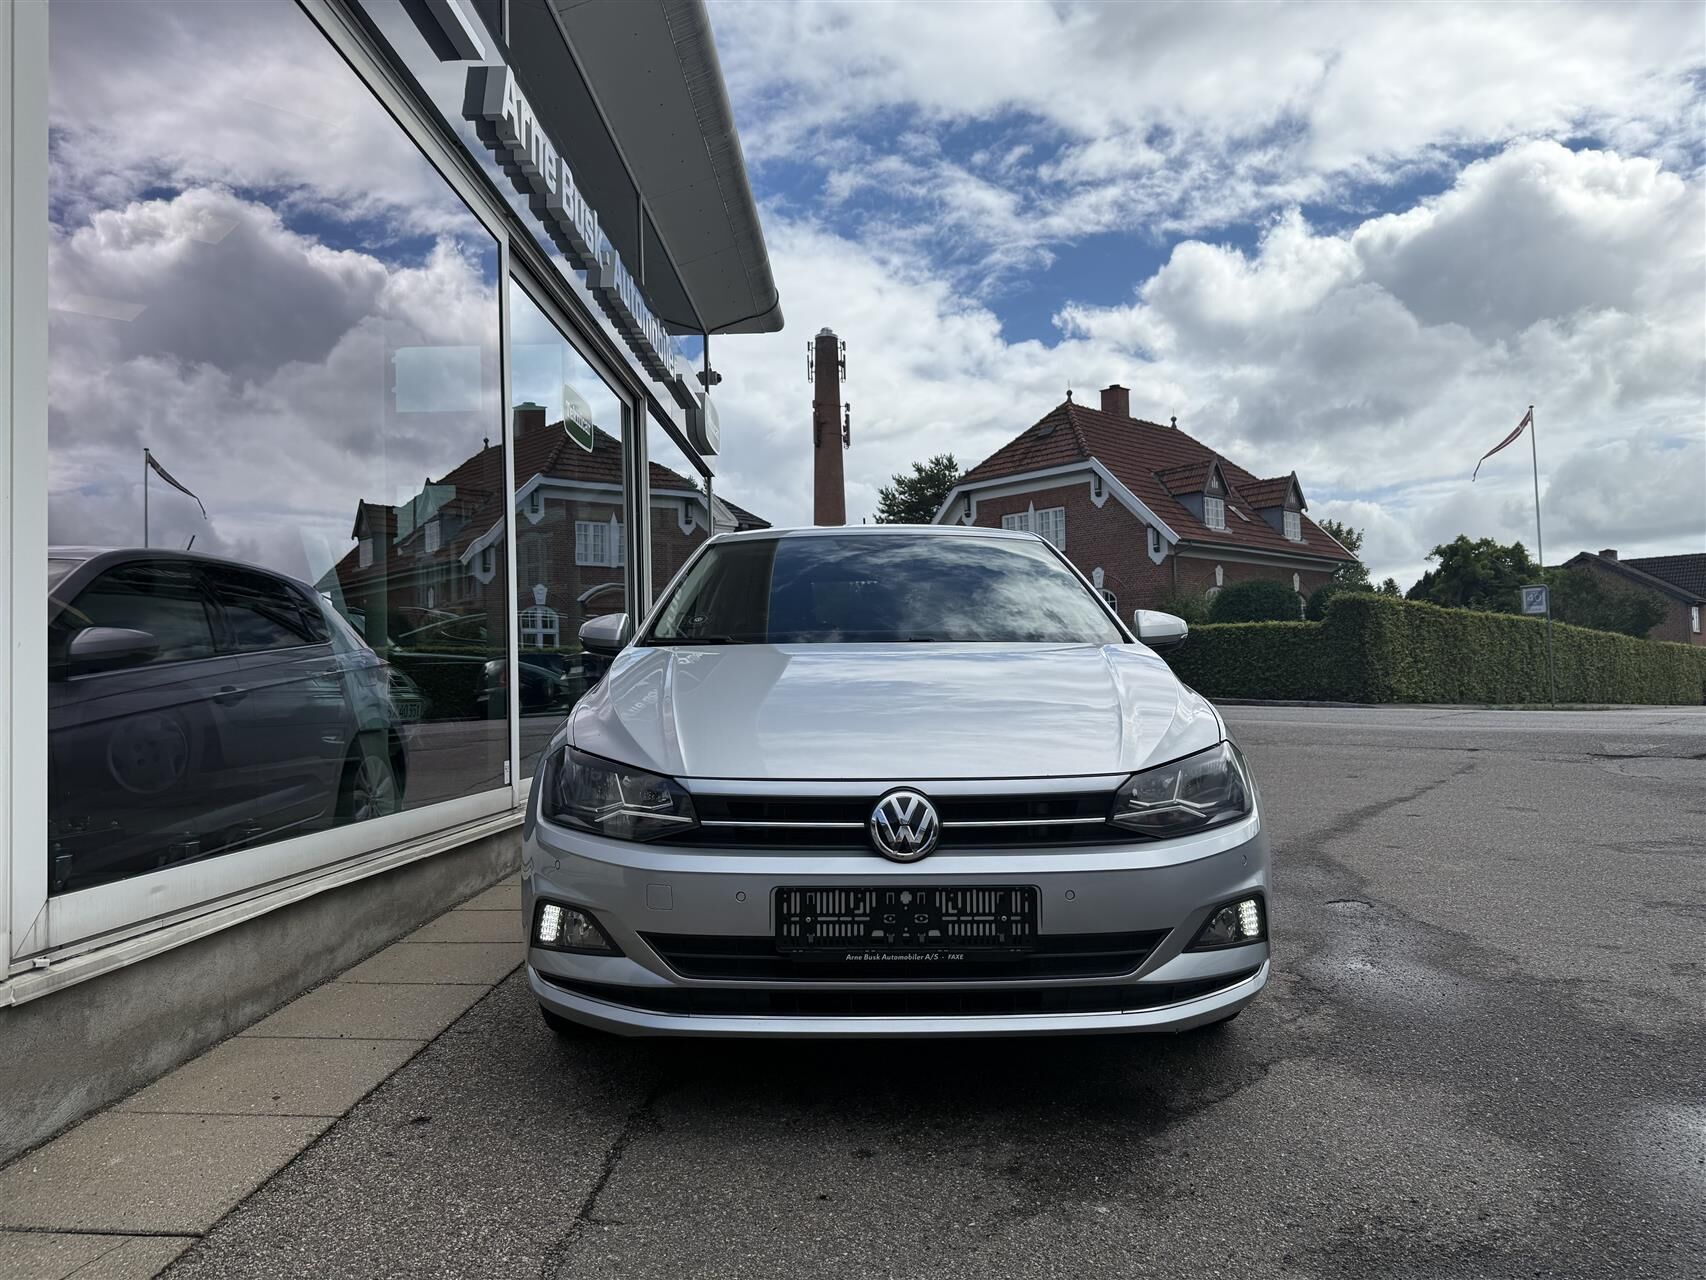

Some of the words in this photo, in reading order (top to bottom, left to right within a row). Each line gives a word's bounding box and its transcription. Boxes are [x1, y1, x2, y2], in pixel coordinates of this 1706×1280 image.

[501, 64, 558, 195] Arne
[561, 157, 605, 272] Busk
[874, 793, 936, 857] VW
[845, 953, 862, 961] Arne
[863, 953, 881, 961] Busk
[881, 953, 924, 961] Automobiler
[924, 953, 939, 961] A/S
